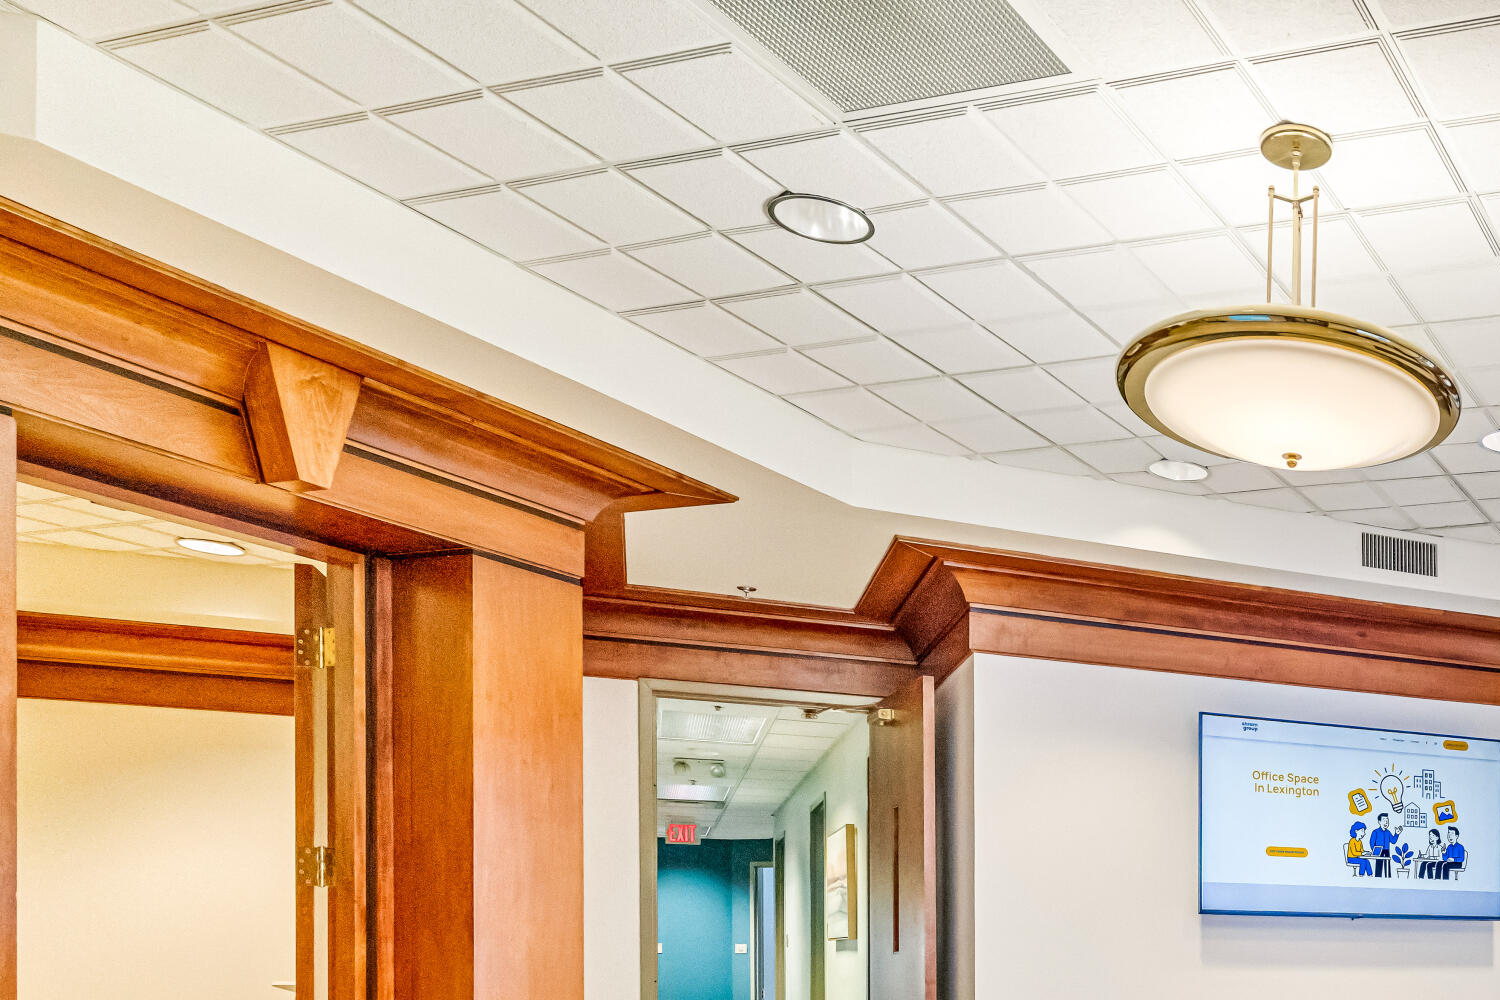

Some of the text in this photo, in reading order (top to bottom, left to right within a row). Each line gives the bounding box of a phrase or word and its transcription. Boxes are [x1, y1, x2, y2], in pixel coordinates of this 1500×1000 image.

[1252, 770, 1320, 786] Office Space
[1254, 782, 1320, 798] In Lexington
[668, 823, 697, 843] EXIT
